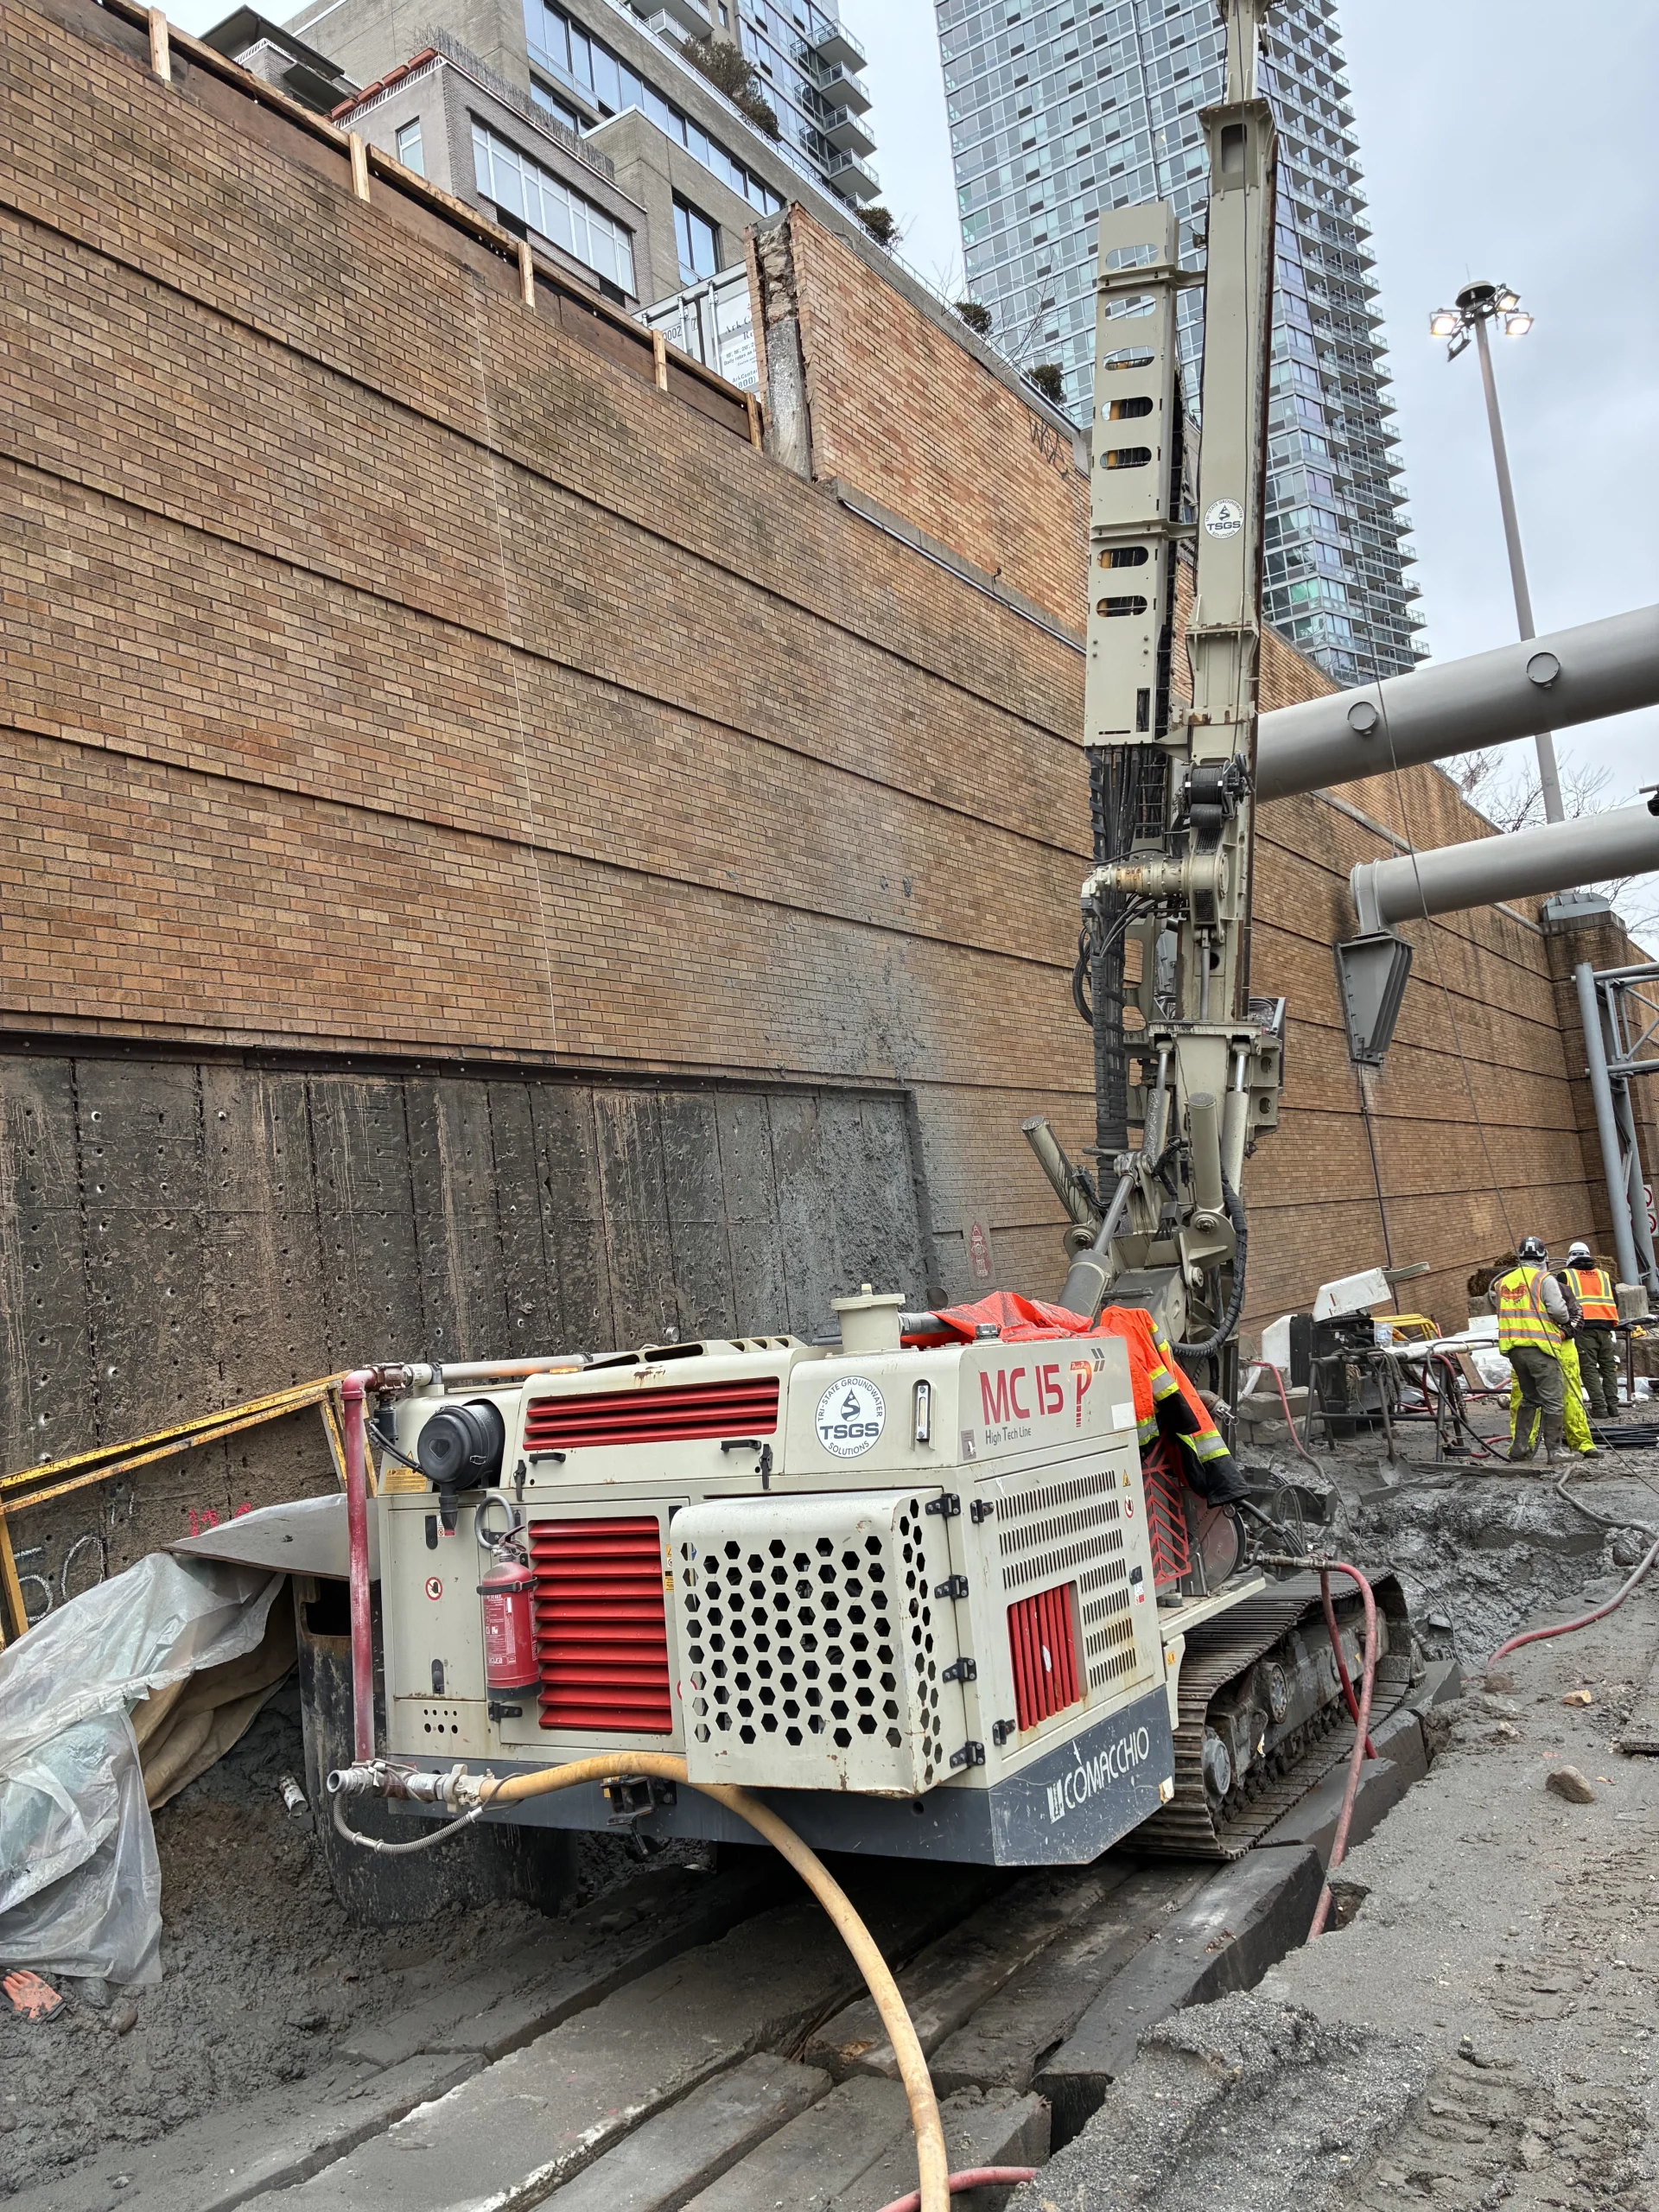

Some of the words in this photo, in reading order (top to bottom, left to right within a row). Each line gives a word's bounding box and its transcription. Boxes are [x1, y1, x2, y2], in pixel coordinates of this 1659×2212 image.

[1207, 521, 1241, 531] TSGS
[817, 1383, 841, 1422] TRI-STATE
[841, 1377, 883, 1418] GROUNDWATER
[979, 1367, 1031, 1426] MC
[819, 1422, 880, 1440] TSGS
[985, 1429, 1002, 1446] High
[1001, 1427, 1019, 1442] Tech
[1019, 1426, 1032, 1439] Line
[828, 1440, 870, 1456] SOLUTIONS
[1064, 1726, 1150, 1809] COMACCHIO
